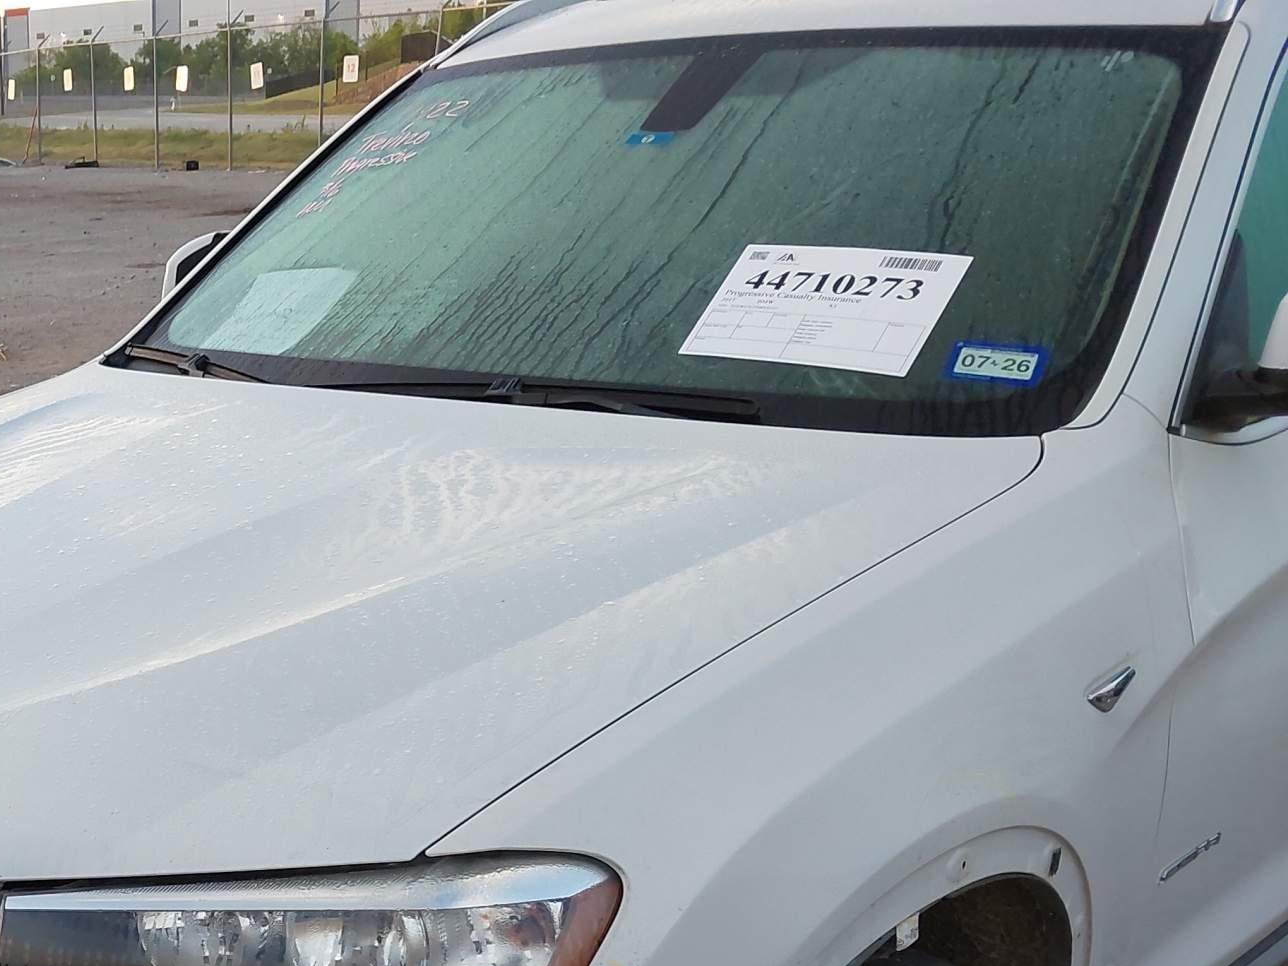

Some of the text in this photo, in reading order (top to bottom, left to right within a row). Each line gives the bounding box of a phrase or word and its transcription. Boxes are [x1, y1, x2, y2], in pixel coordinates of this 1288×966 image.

[724, 288, 862, 304] Progressive Casualty Insurance
[744, 269, 925, 301] 44710273
